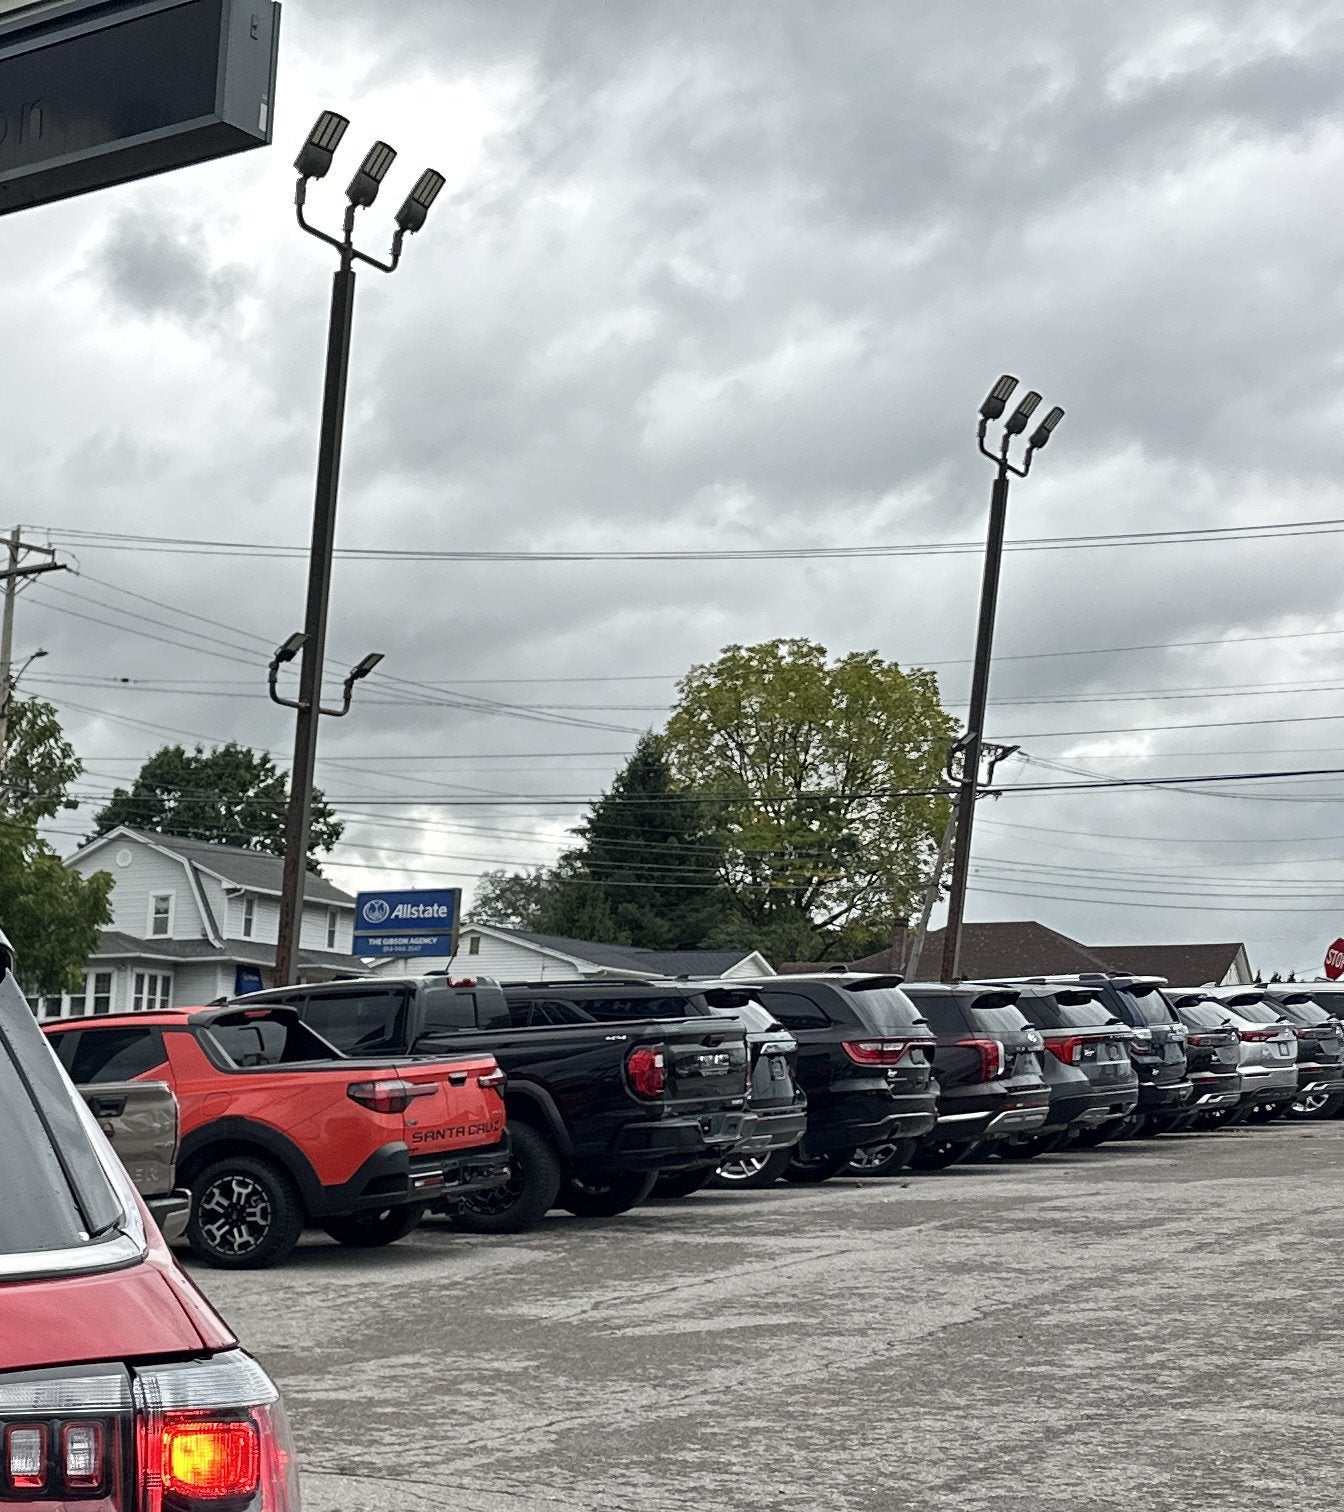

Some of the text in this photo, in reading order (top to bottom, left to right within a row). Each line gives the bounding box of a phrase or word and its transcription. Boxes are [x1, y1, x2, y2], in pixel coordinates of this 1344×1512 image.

[390, 903, 448, 919] Allstate
[368, 938, 382, 946] THE
[409, 937, 438, 945] AGENCY
[412, 1121, 500, 1143] SANTA CRUZ
